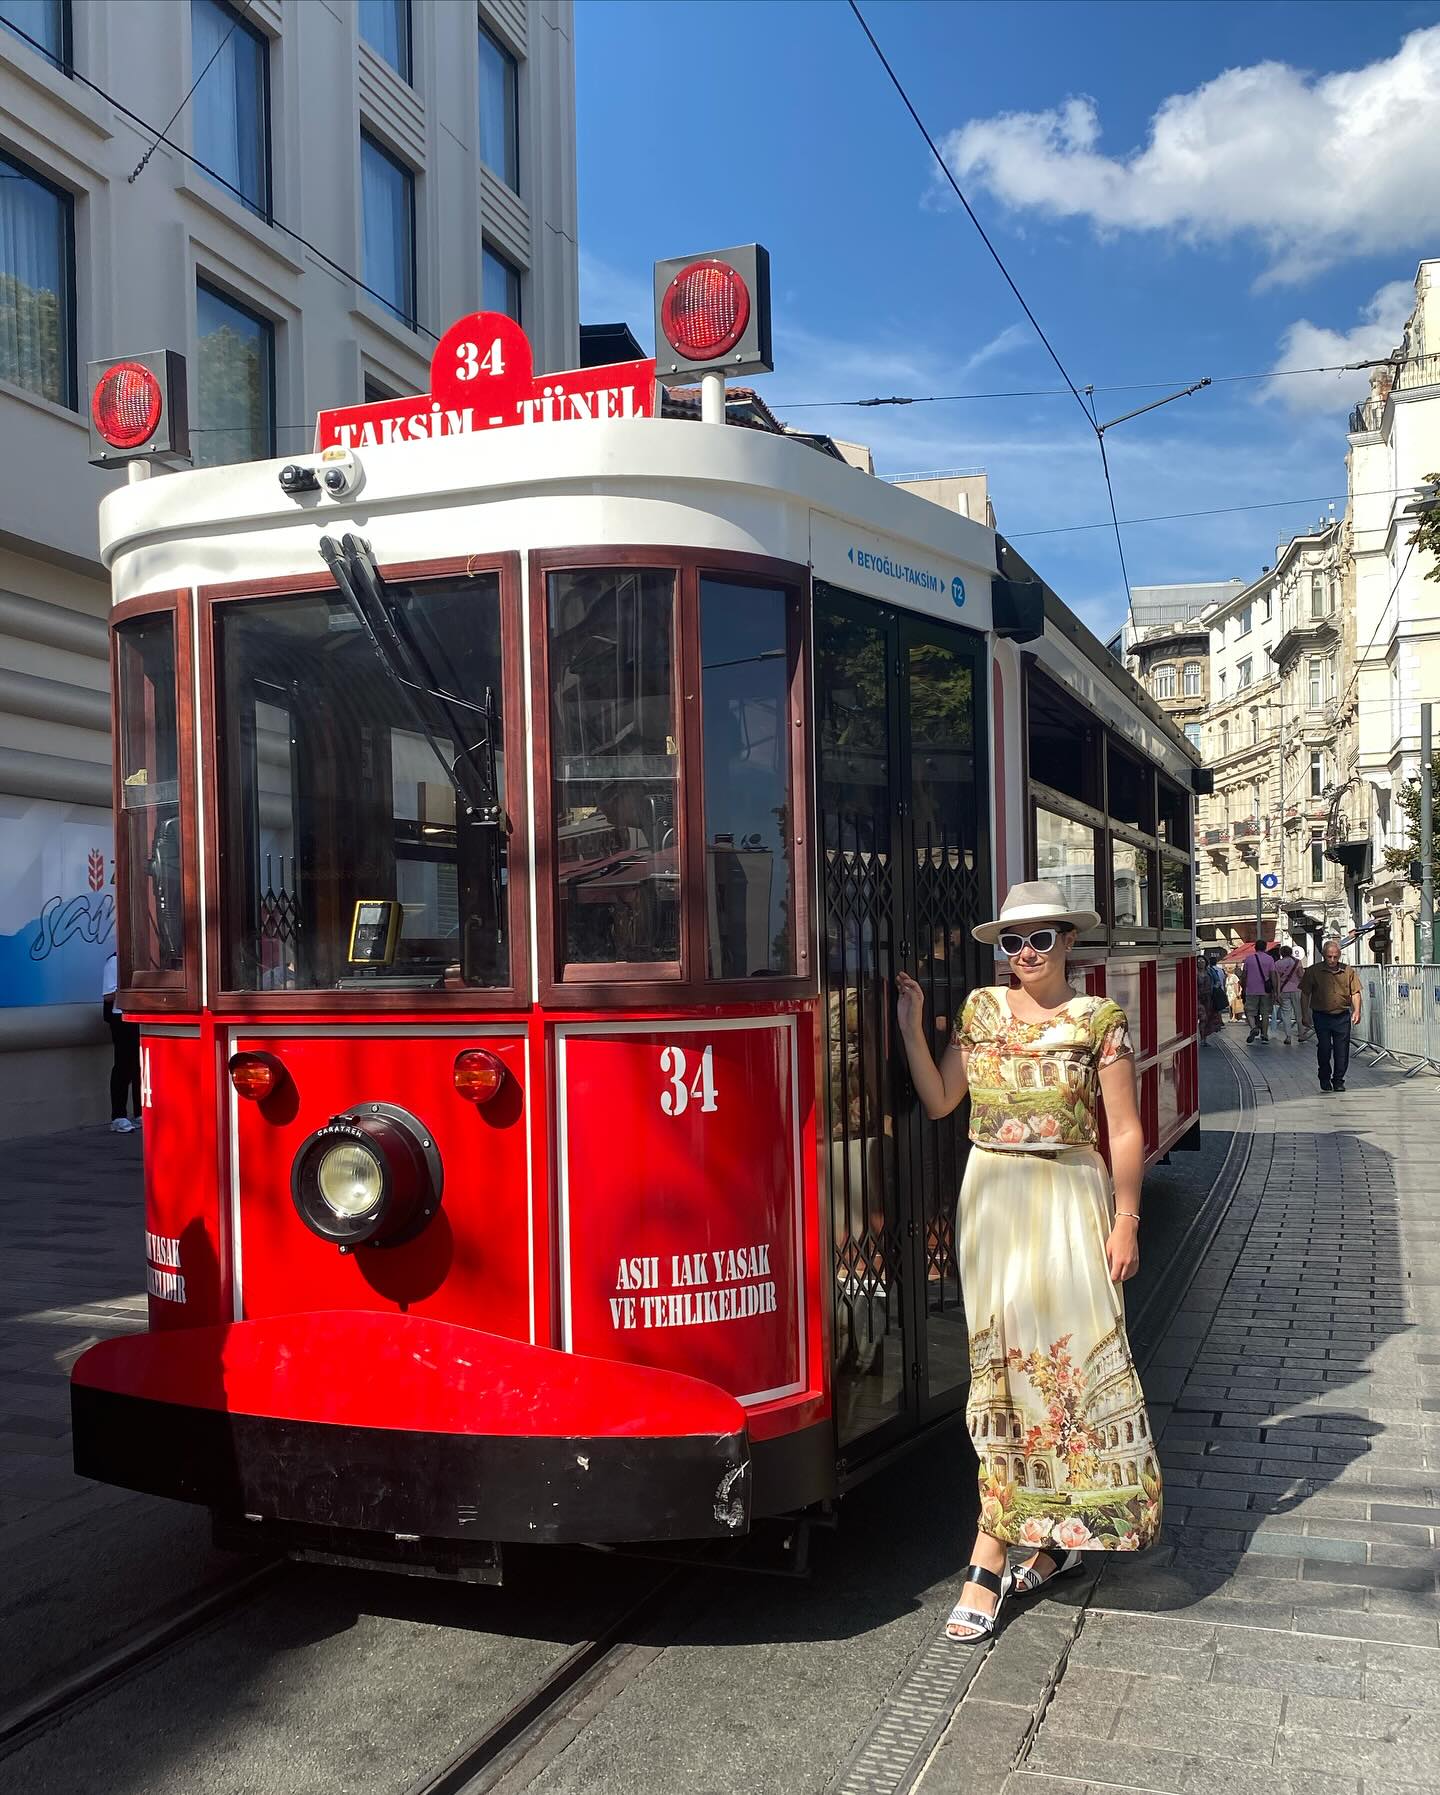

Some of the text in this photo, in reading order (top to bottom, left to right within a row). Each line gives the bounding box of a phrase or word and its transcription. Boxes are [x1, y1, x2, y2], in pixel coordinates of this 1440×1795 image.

[455, 337, 506, 381] 34
[334, 402, 475, 449] TAKSİM
[516, 385, 644, 425] TÜNEL
[857, 551, 938, 592] BEYOĞLU-TAKSİM
[660, 1045, 719, 1116] 34
[151, 1234, 182, 1268] YASAK
[712, 1243, 771, 1283] YASAK
[609, 1281, 778, 1330] VE TEHLIKELIDIR
